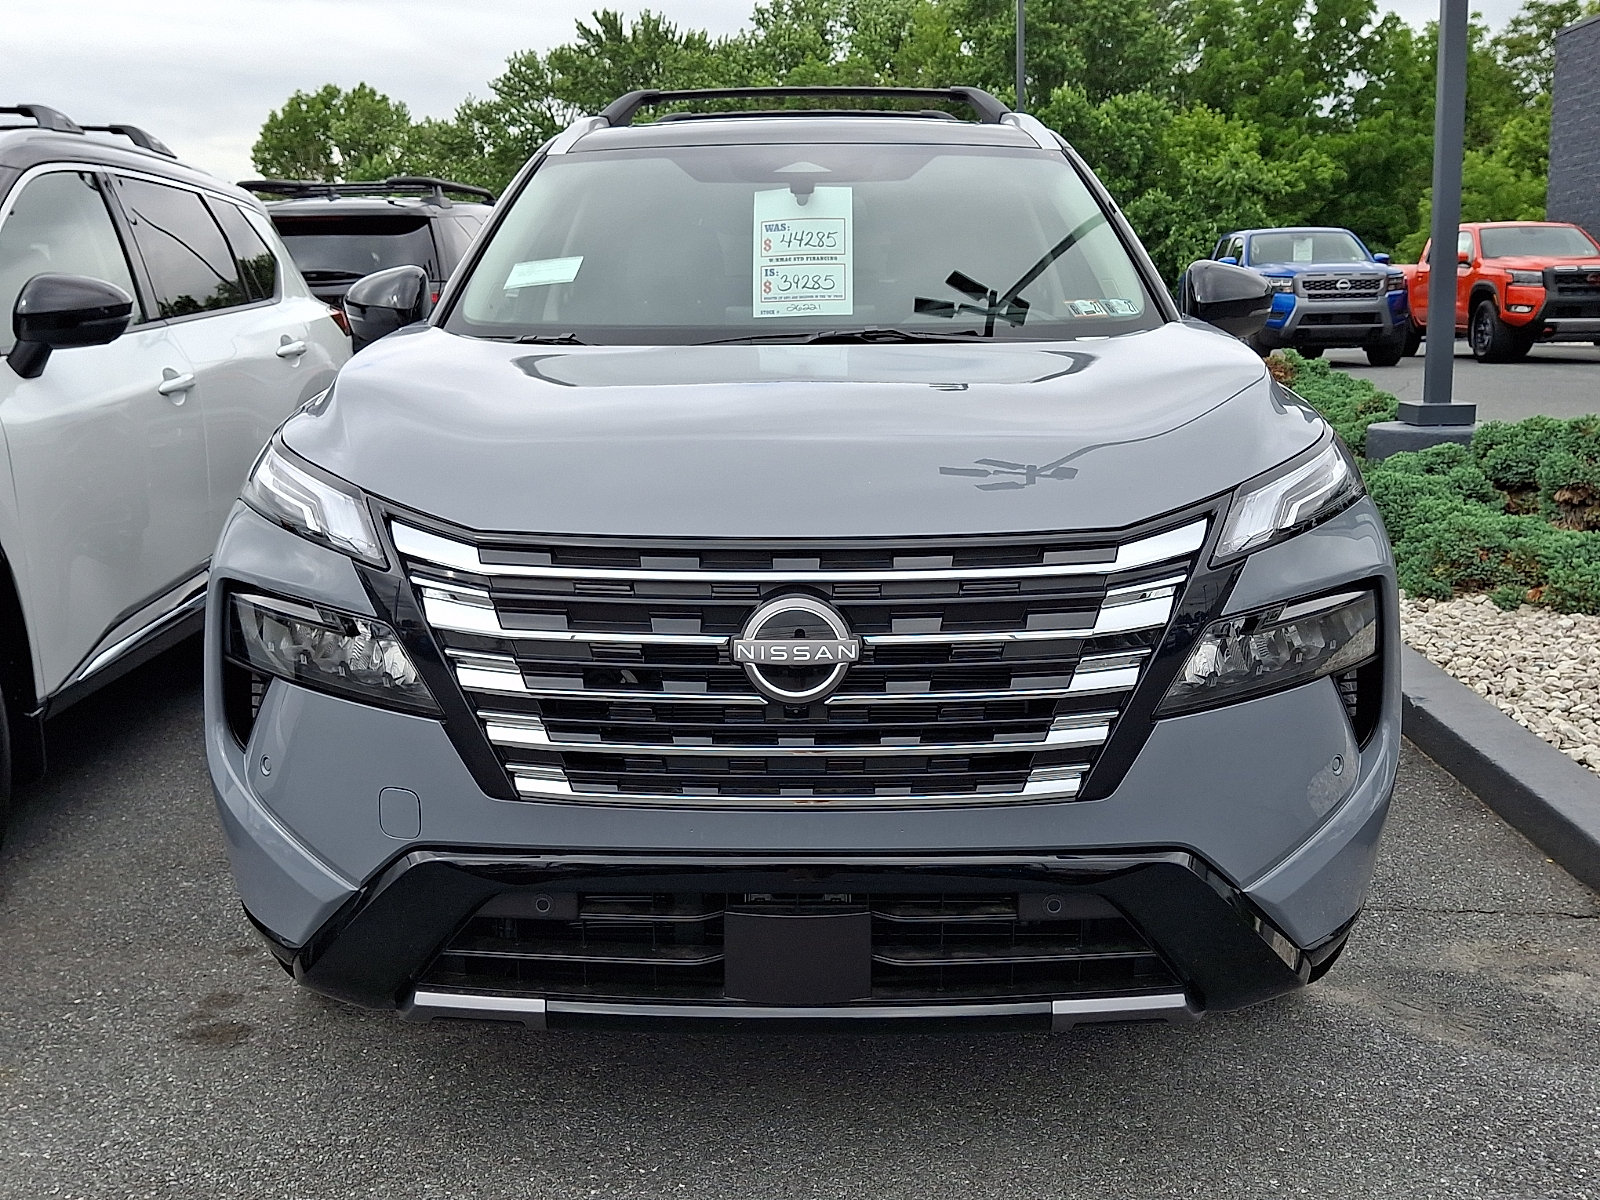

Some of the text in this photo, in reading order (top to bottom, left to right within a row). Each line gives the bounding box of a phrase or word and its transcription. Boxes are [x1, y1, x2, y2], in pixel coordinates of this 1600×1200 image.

[764, 223, 791, 233] WAS:
[764, 230, 838, 252] $ 44285
[764, 268, 779, 277] IS:
[764, 274, 836, 294] $ 39285
[786, 303, 822, 312] 26221
[736, 644, 856, 661] NISSAN
